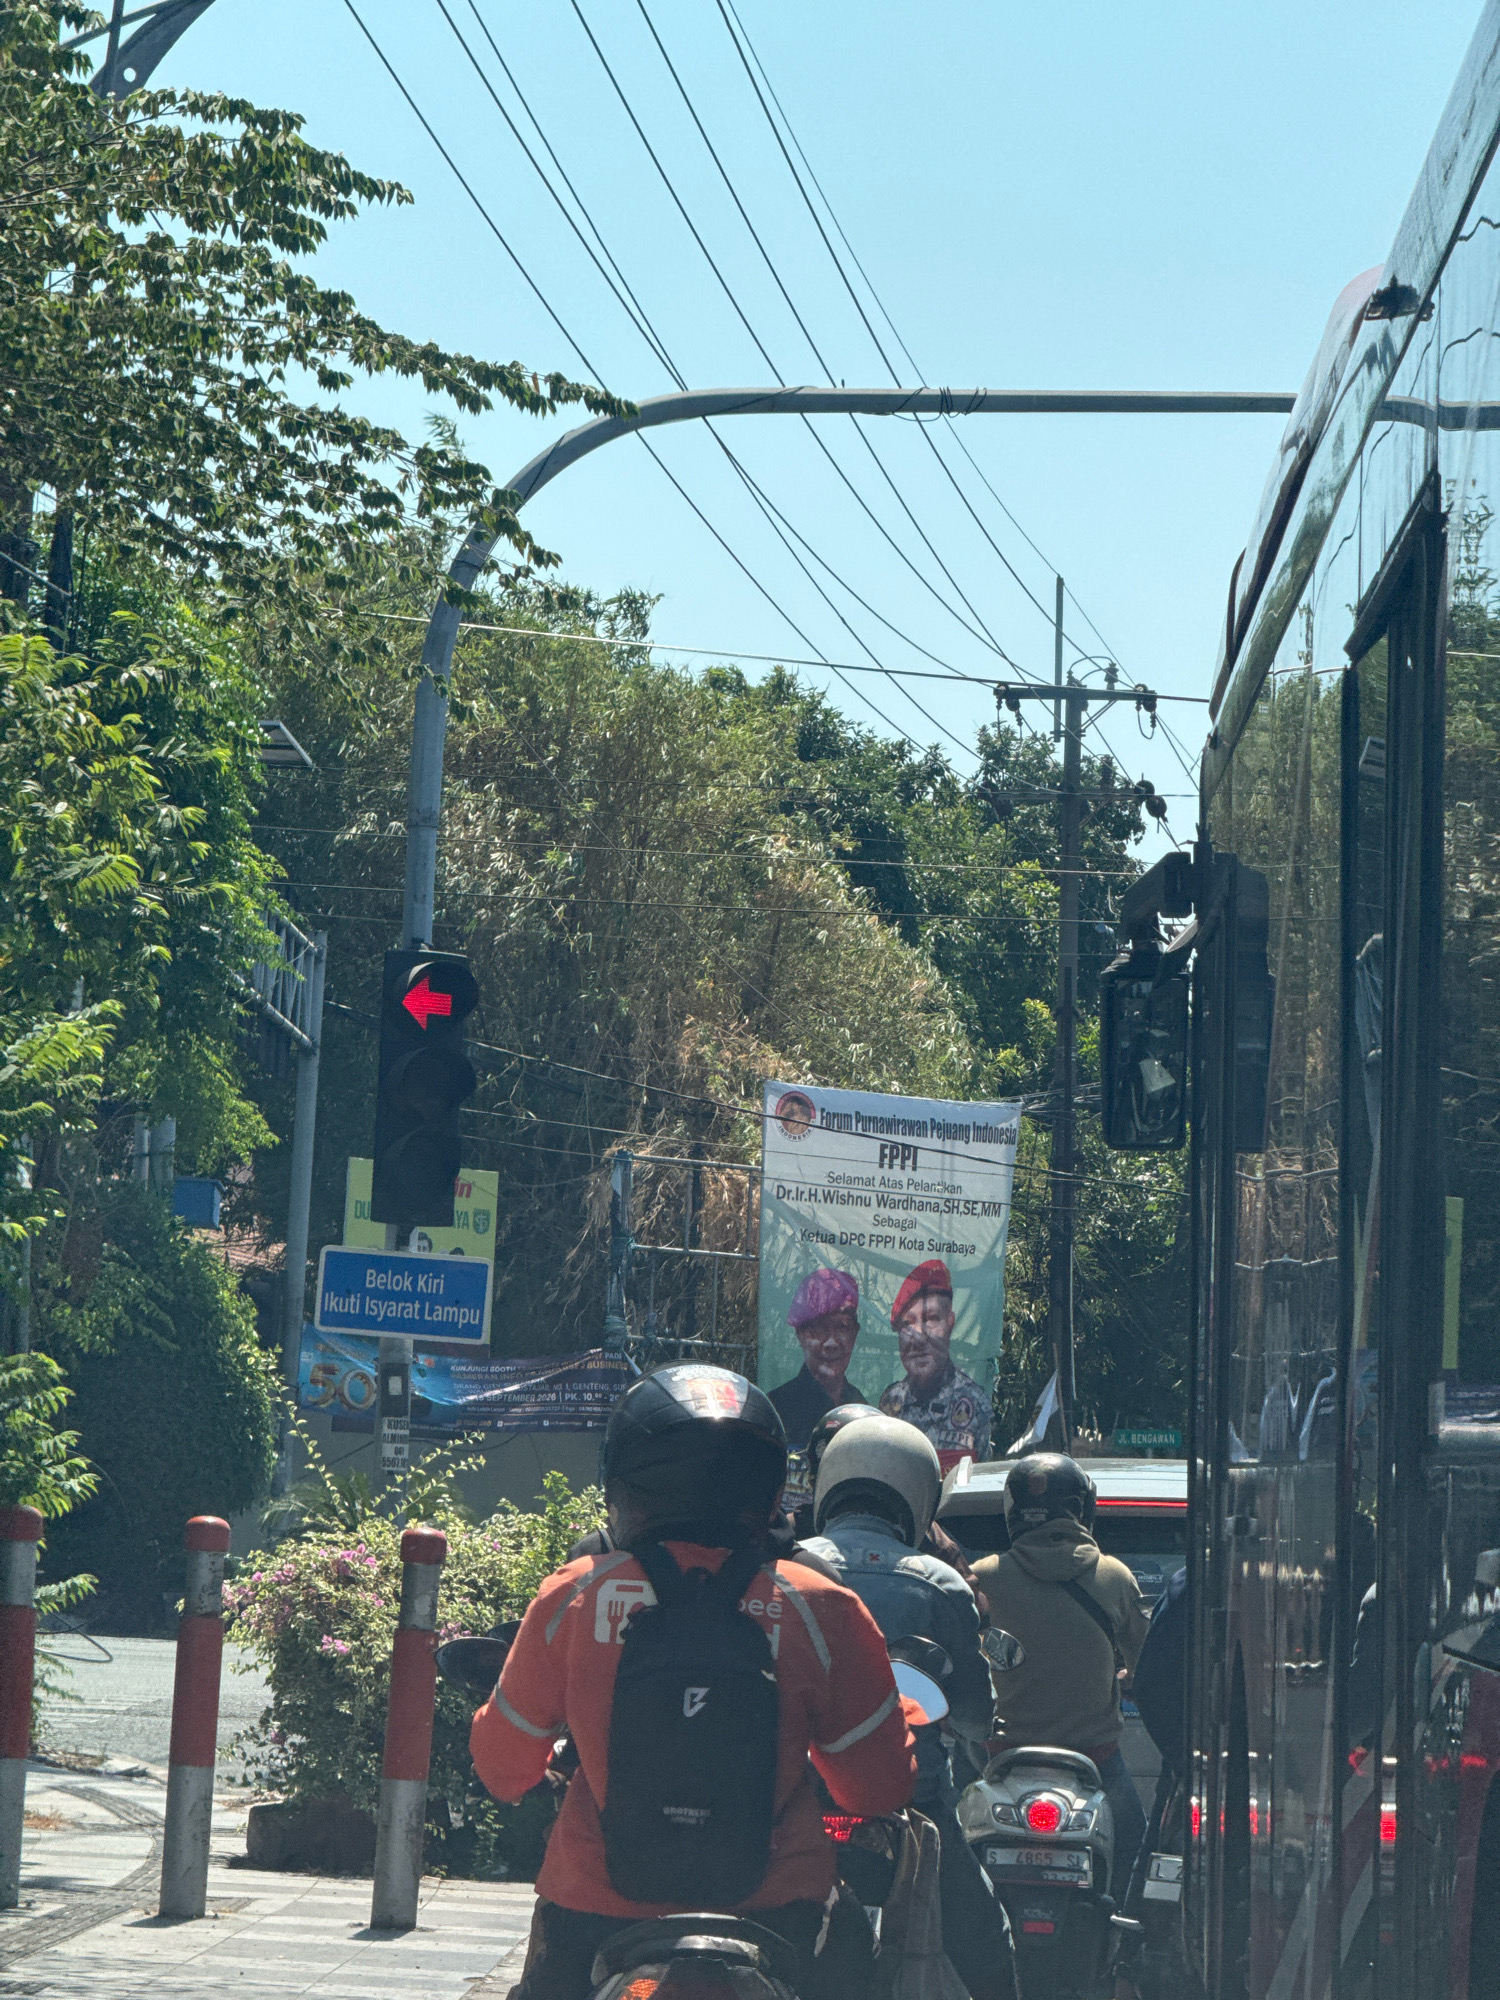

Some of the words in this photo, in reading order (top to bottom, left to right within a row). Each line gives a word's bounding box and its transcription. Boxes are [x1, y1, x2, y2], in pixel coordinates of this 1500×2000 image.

[820, 1107, 853, 1131] Forum
[854, 1110, 928, 1138] Purnawirawan
[929, 1120, 970, 1144] Pejuang
[972, 1121, 1017, 1146] Indonesia
[878, 1143, 918, 1171] FPPI
[827, 1171, 876, 1188] Selamat
[878, 1176, 904, 1190] Atas
[907, 1178, 962, 1195] Pelantikan
[776, 1184, 871, 1208] Dr.Ir.H.Wishnu
[354, 1200, 372, 1220] DU
[452, 1210, 470, 1230] YA
[872, 1214, 917, 1232] Sebagai
[800, 1228, 836, 1245] Ketua
[840, 1232, 865, 1247] DPC
[868, 1234, 896, 1249] FPPI
[899, 1236, 926, 1250] Kota
[927, 1240, 976, 1255] Surabaya
[365, 1268, 413, 1292] Belok
[417, 1272, 445, 1295] Kiri
[324, 1291, 361, 1315] Ikuti
[364, 1295, 420, 1322] Isyarat
[424, 1301, 481, 1329] Lampu
[450, 1365, 488, 1373] KUNJUNGI
[486, 1393, 535, 1402] SEPTEMBER
[1131, 1433, 1175, 1444] BENGAWAN
[737, 1598, 782, 1619] ee
[989, 1850, 997, 1864] S
